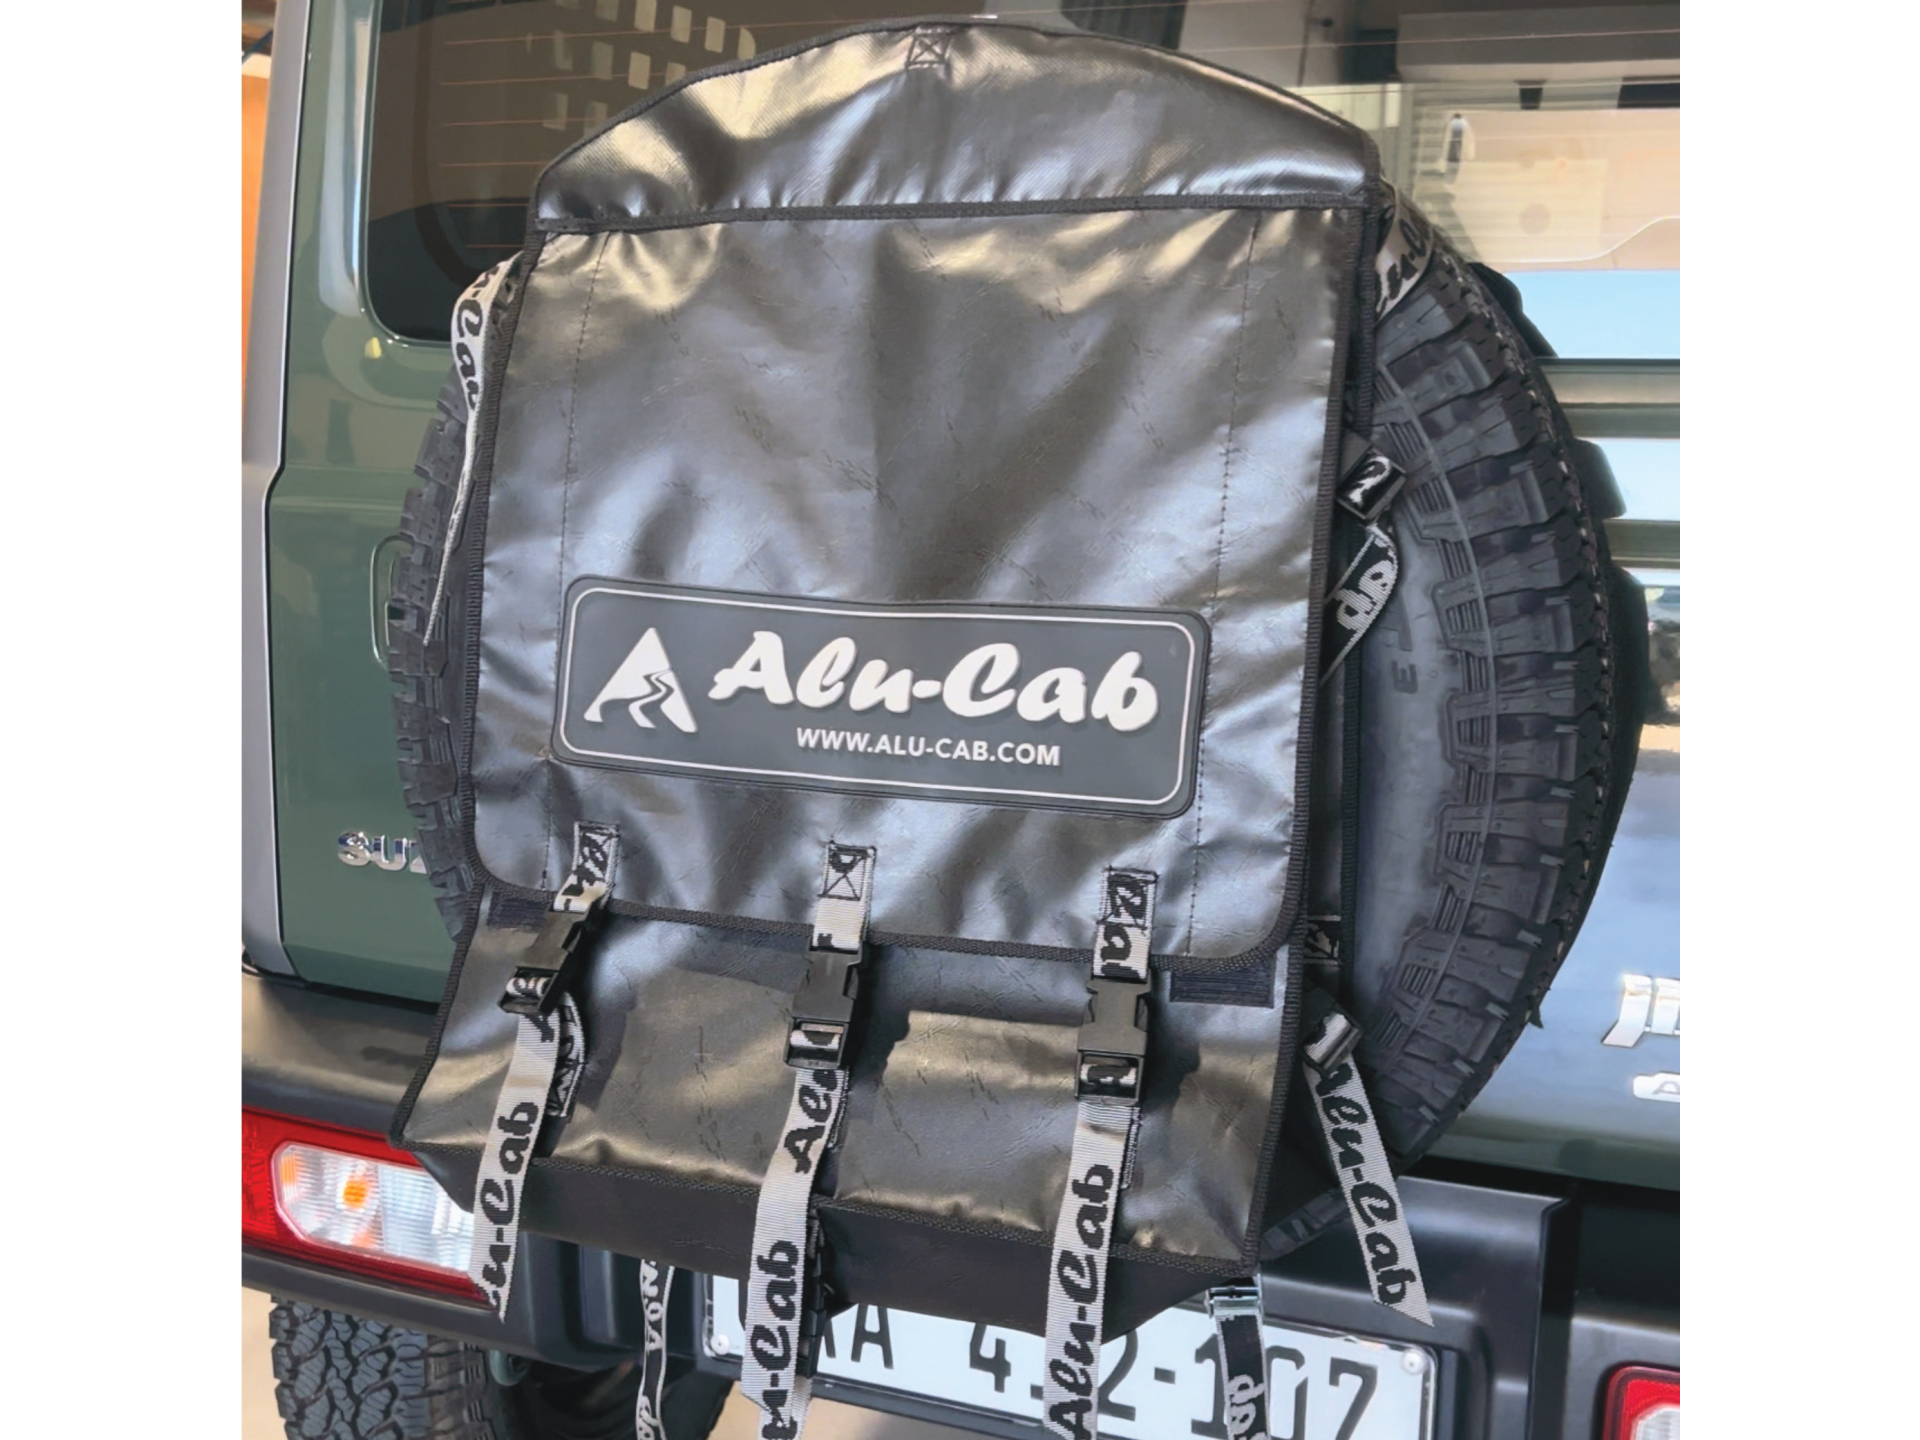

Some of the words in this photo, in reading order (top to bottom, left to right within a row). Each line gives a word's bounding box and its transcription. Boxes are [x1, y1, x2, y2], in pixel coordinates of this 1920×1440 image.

[708, 630, 1159, 733] Alu-Cab
[796, 727, 1061, 767] WWW.ALU-CAB.COM
[482, 1101, 541, 1305] u-Cab
